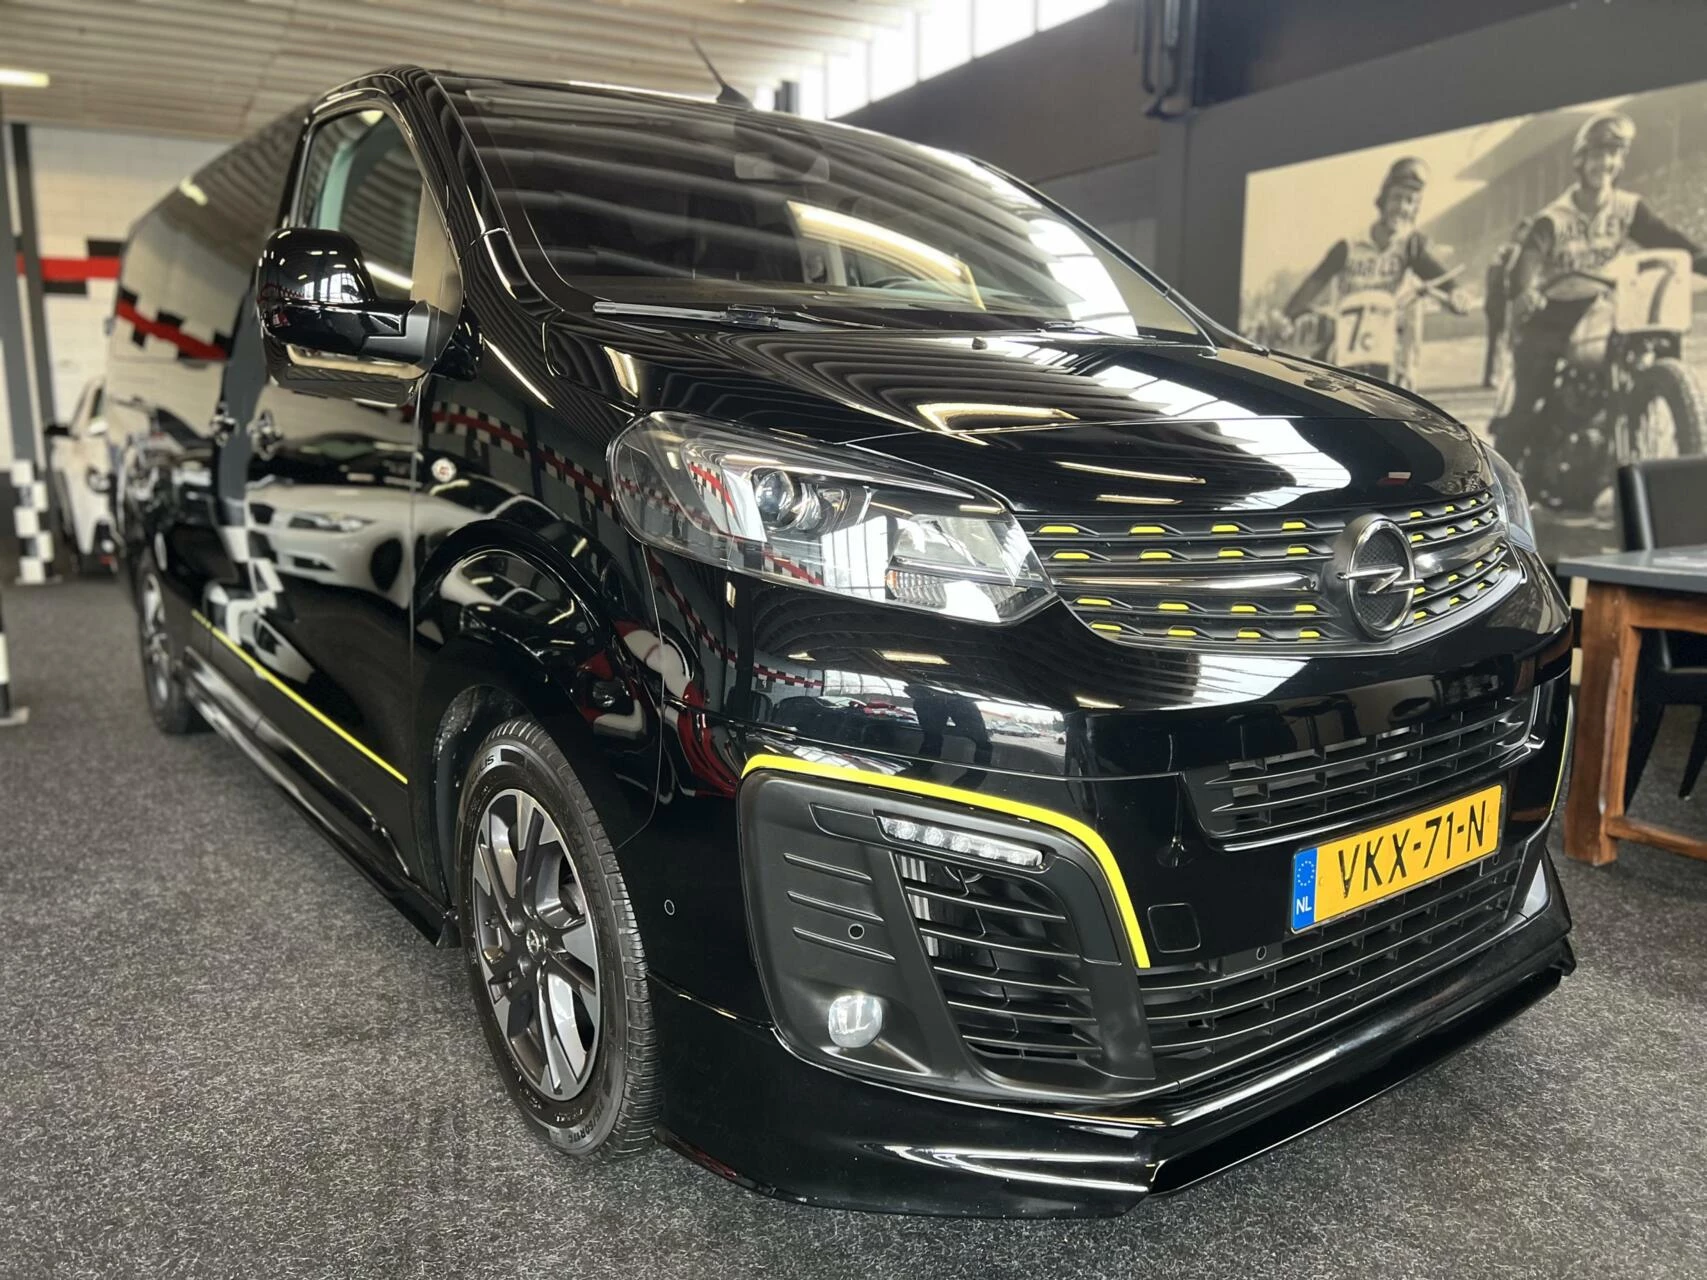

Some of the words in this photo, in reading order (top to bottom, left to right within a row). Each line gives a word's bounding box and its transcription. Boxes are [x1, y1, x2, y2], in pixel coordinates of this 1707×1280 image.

[1637, 256, 1675, 325] 7
[1338, 800, 1486, 899] VKX-71-N
[1296, 896, 1312, 915] NL
